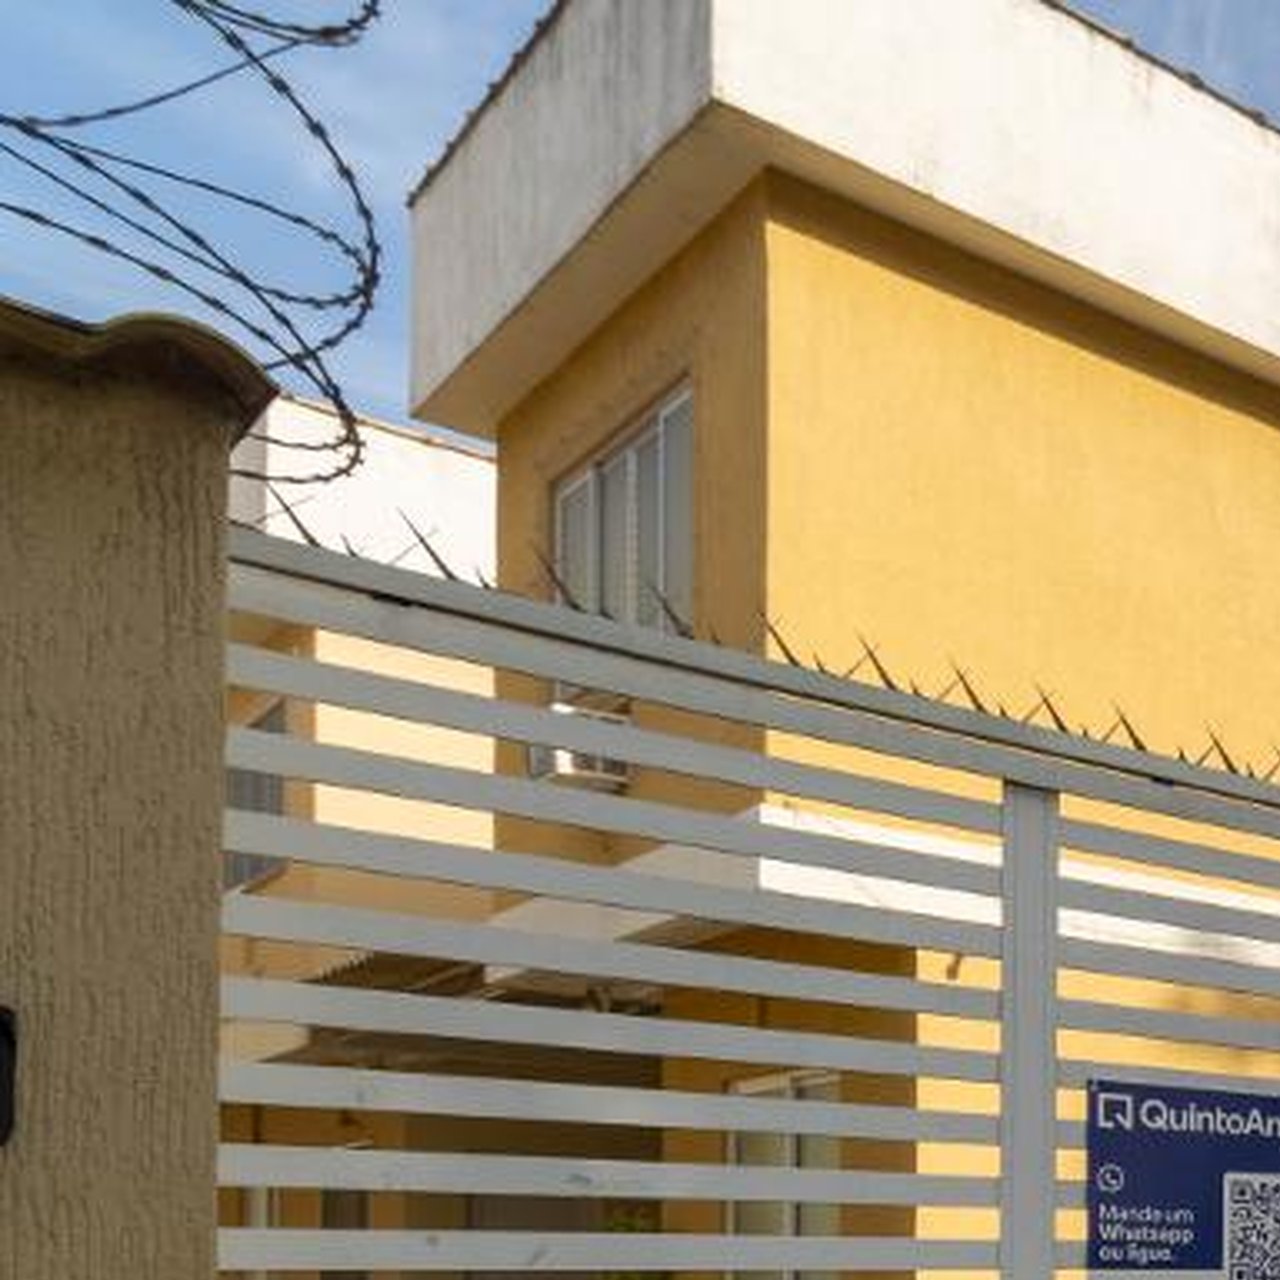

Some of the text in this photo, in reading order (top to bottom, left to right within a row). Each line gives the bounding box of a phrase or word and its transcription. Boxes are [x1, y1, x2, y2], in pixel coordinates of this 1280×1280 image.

[1099, 1203, 1195, 1224] Mande um
[1098, 1245, 1124, 1262] ou
